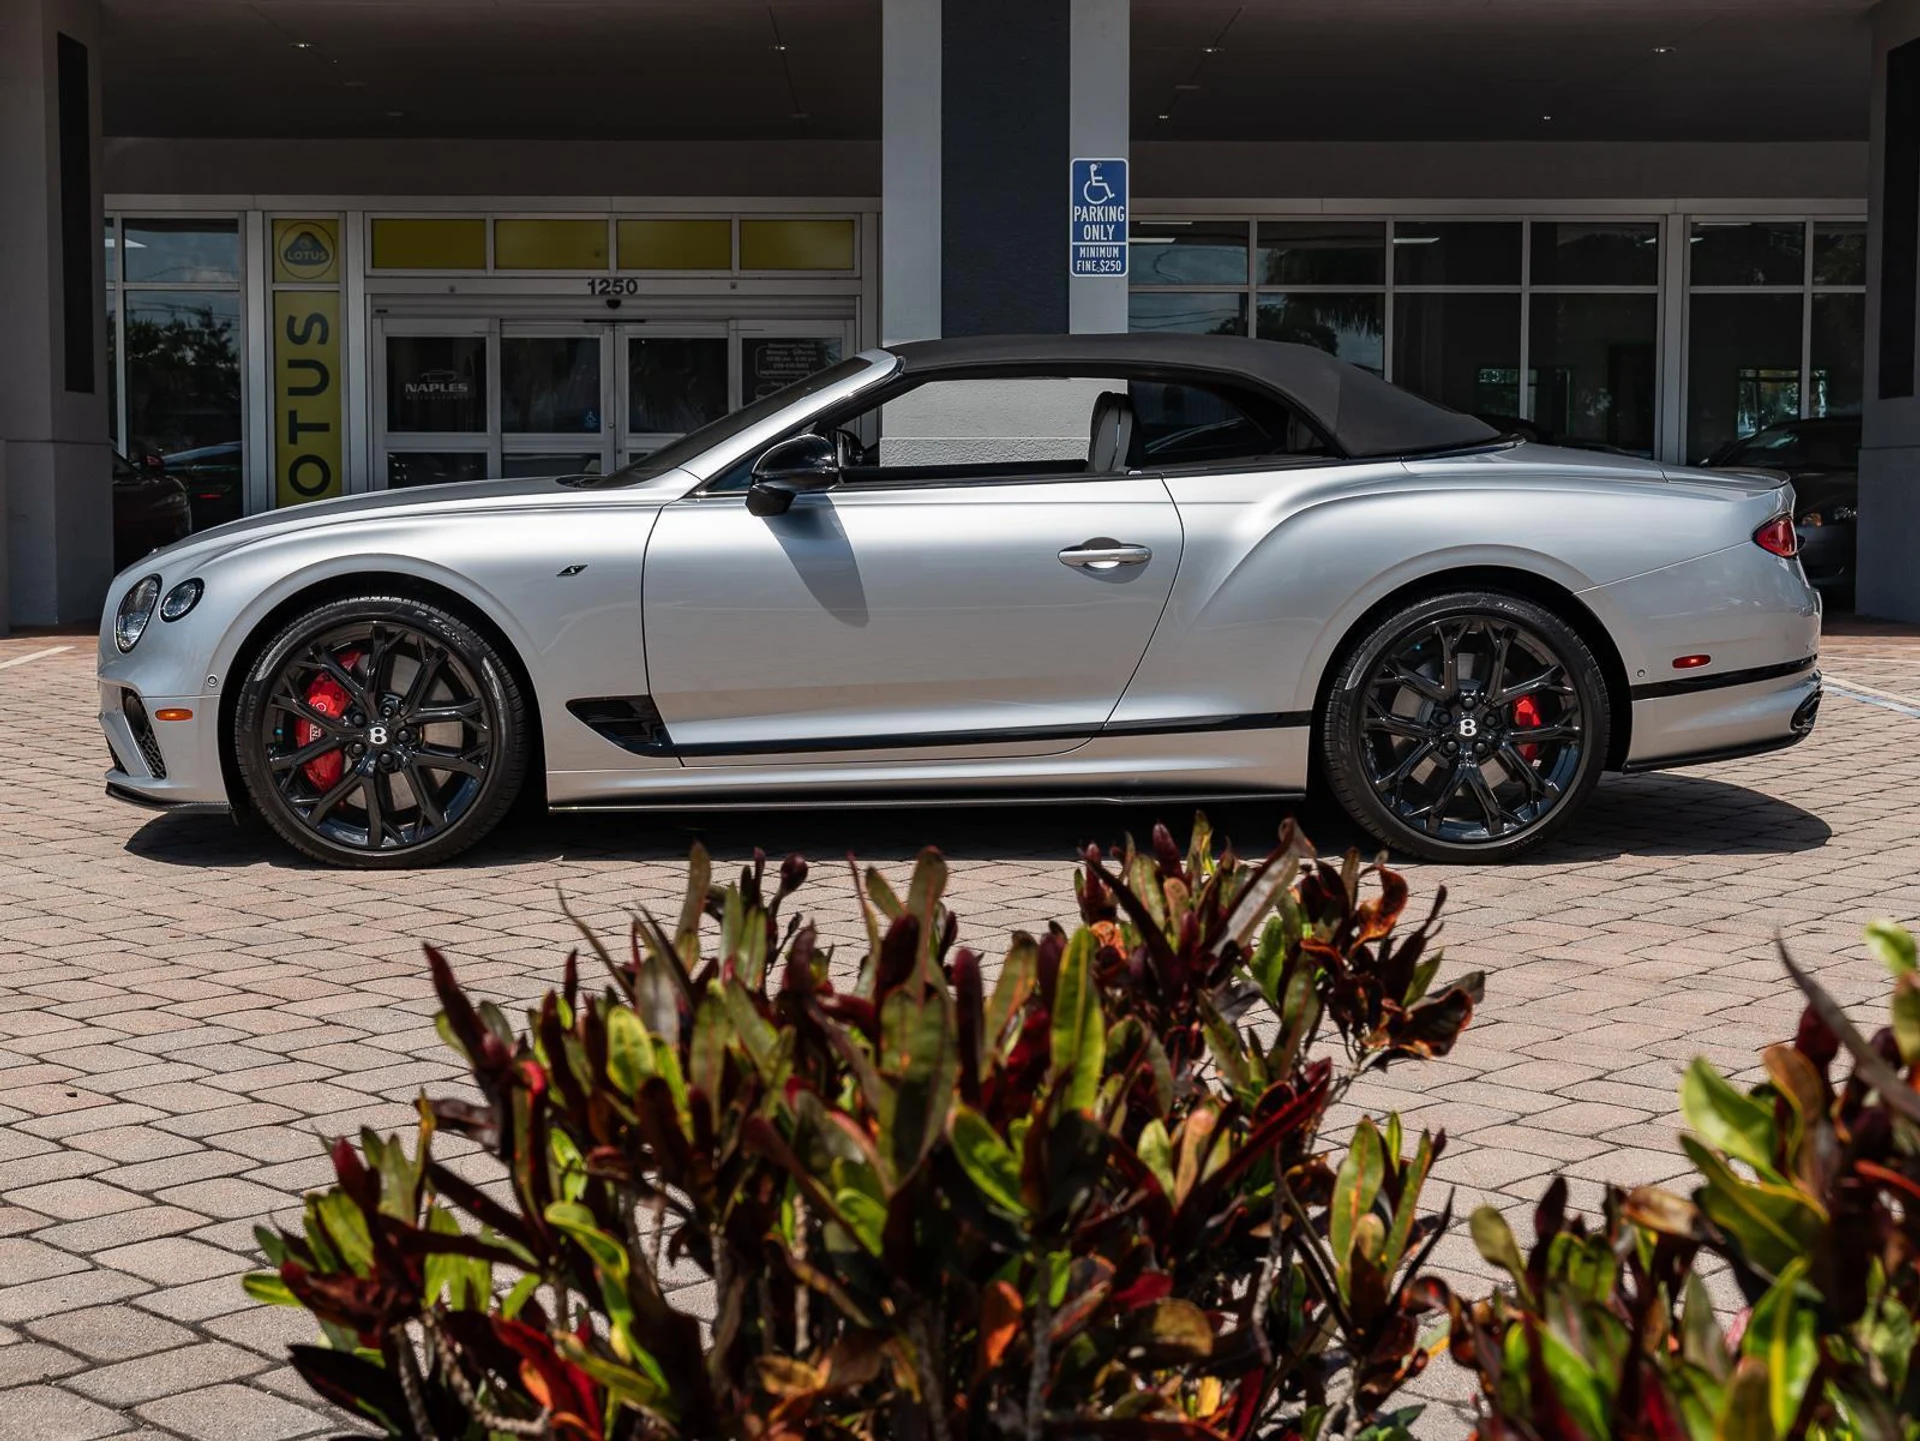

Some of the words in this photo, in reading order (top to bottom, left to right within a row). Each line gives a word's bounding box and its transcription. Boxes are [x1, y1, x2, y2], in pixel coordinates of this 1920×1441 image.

[1074, 206, 1125, 222] PARKING
[1083, 224, 1115, 241] ONLY
[287, 250, 326, 261] LOTUS
[1079, 246, 1120, 258] MINIMUM
[1076, 260, 1098, 271] FINE
[1099, 259, 1122, 273] $250
[587, 278, 638, 296] 1250
[405, 383, 468, 393] NAPLES
[286, 312, 331, 497] OTUS
[369, 726, 388, 744] B
[1460, 718, 1477, 736] B
